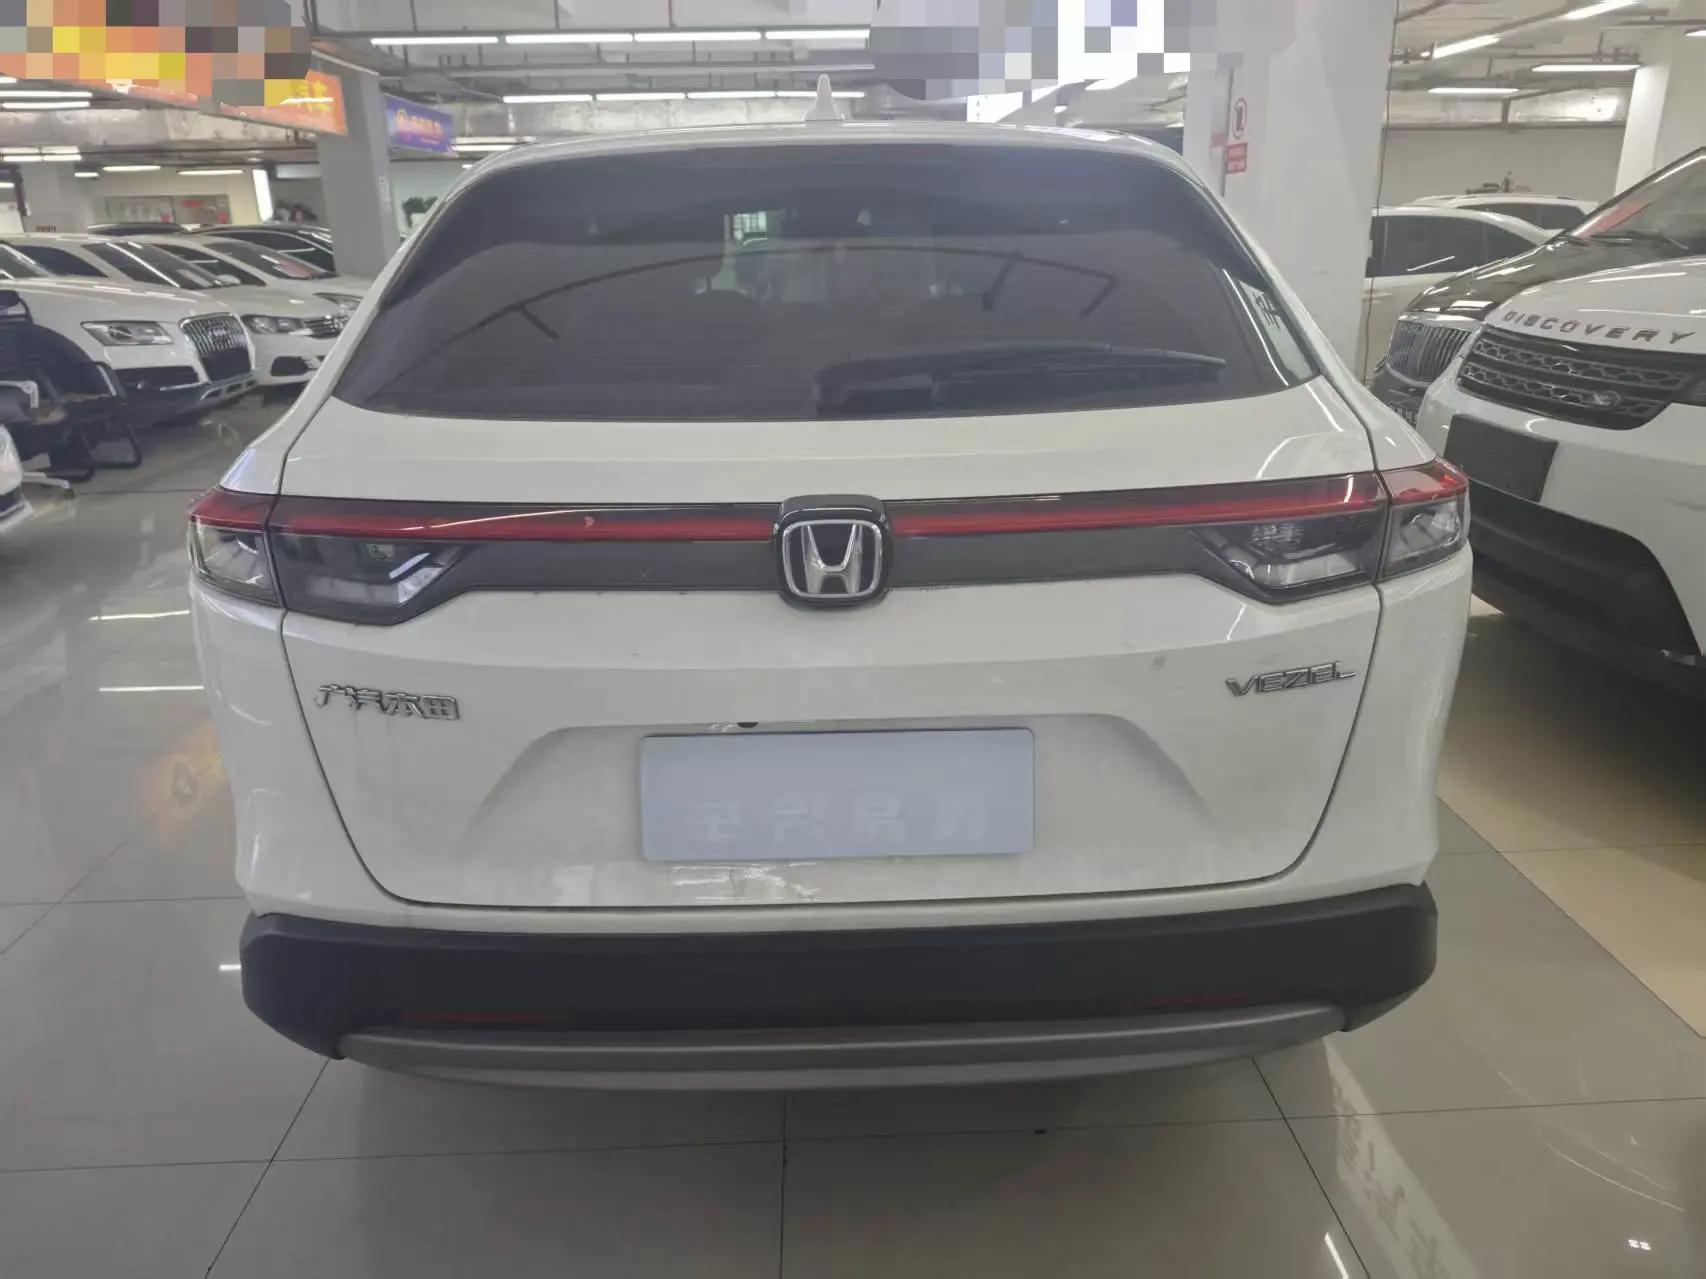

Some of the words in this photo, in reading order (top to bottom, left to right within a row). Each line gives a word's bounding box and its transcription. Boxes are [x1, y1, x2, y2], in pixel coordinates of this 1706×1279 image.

[1503, 313, 1696, 344] DISCOVERY
[1225, 660, 1357, 696] VEZEL
[315, 684, 460, 720] 广汽本田
